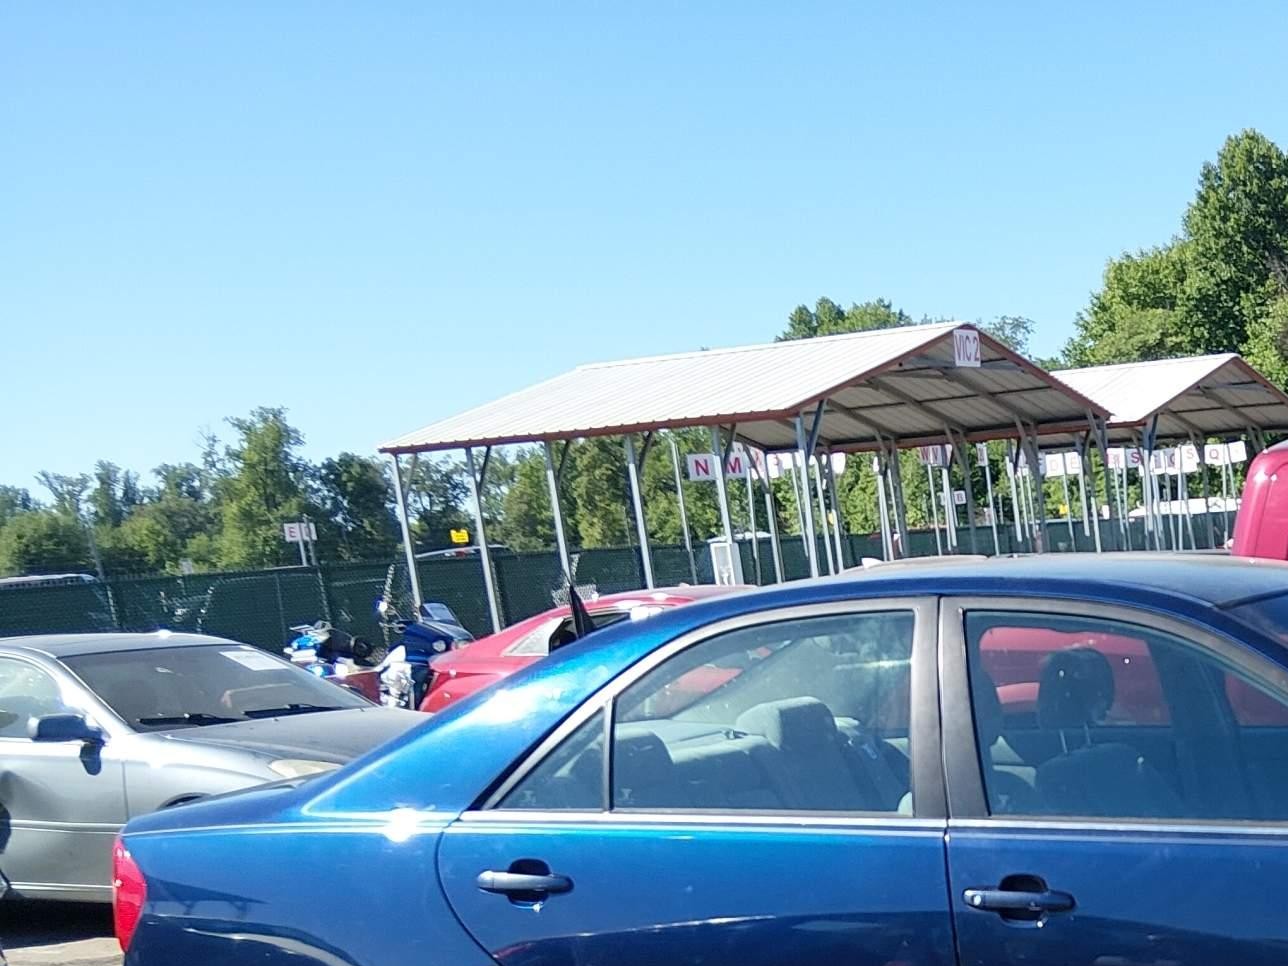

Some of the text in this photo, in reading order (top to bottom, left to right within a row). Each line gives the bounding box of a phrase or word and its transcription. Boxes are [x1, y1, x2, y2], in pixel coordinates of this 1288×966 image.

[955, 334, 980, 361] VIC 2
[1130, 452, 1141, 463] S
[1209, 449, 1220, 460] Q
[694, 458, 710, 476] N
[727, 456, 742, 474] M
[288, 526, 297, 538] E
